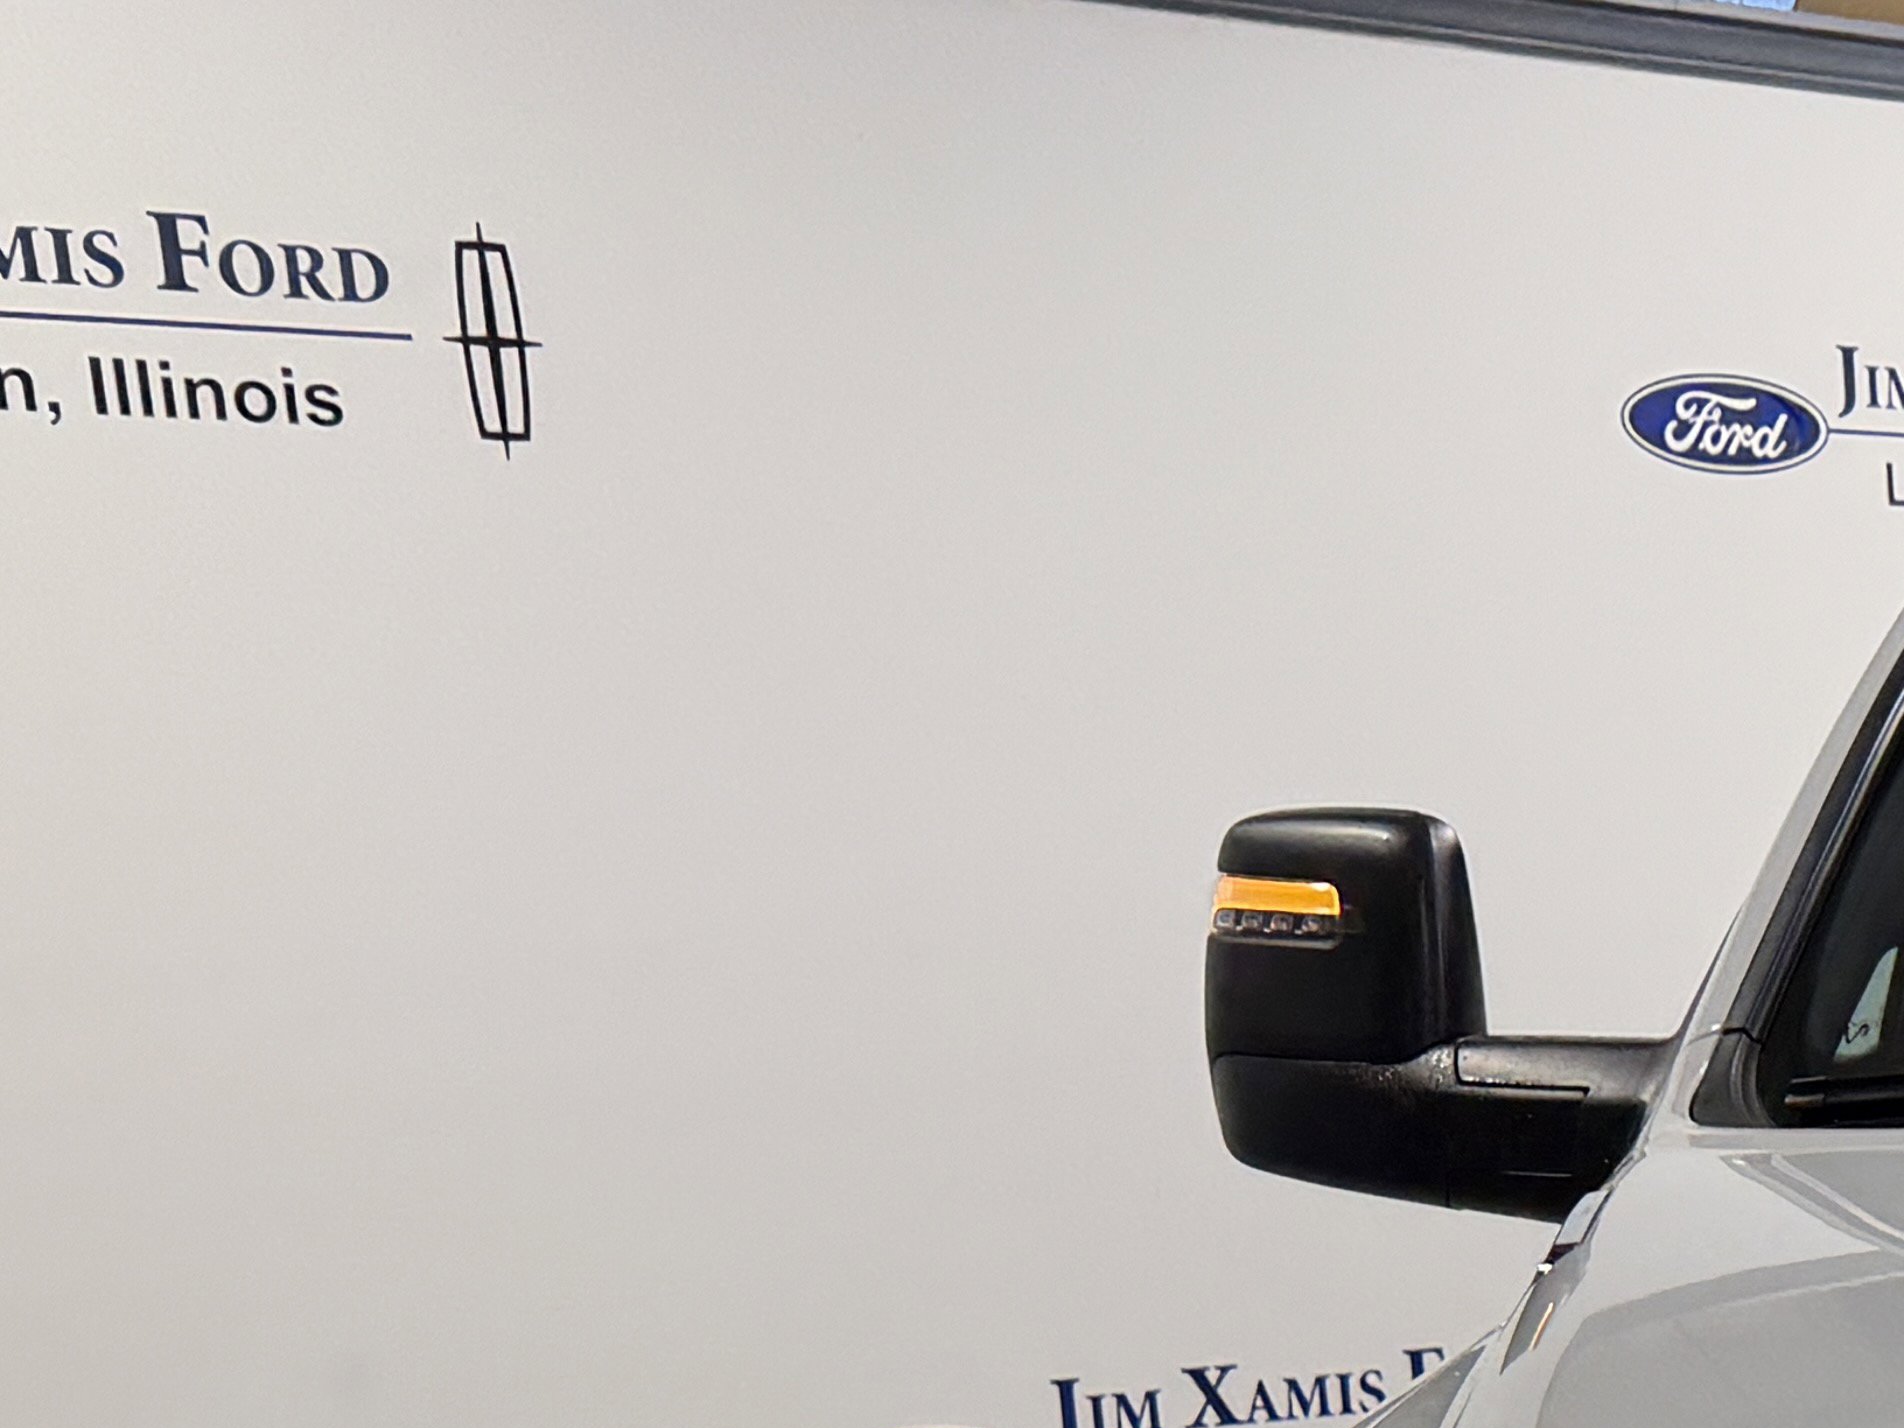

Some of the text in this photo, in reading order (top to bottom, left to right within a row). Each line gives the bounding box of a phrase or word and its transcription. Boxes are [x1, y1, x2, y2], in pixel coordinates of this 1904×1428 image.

[146, 211, 389, 302] FORD
[89, 357, 343, 426] Illinois
[1664, 389, 1789, 459] Ford
